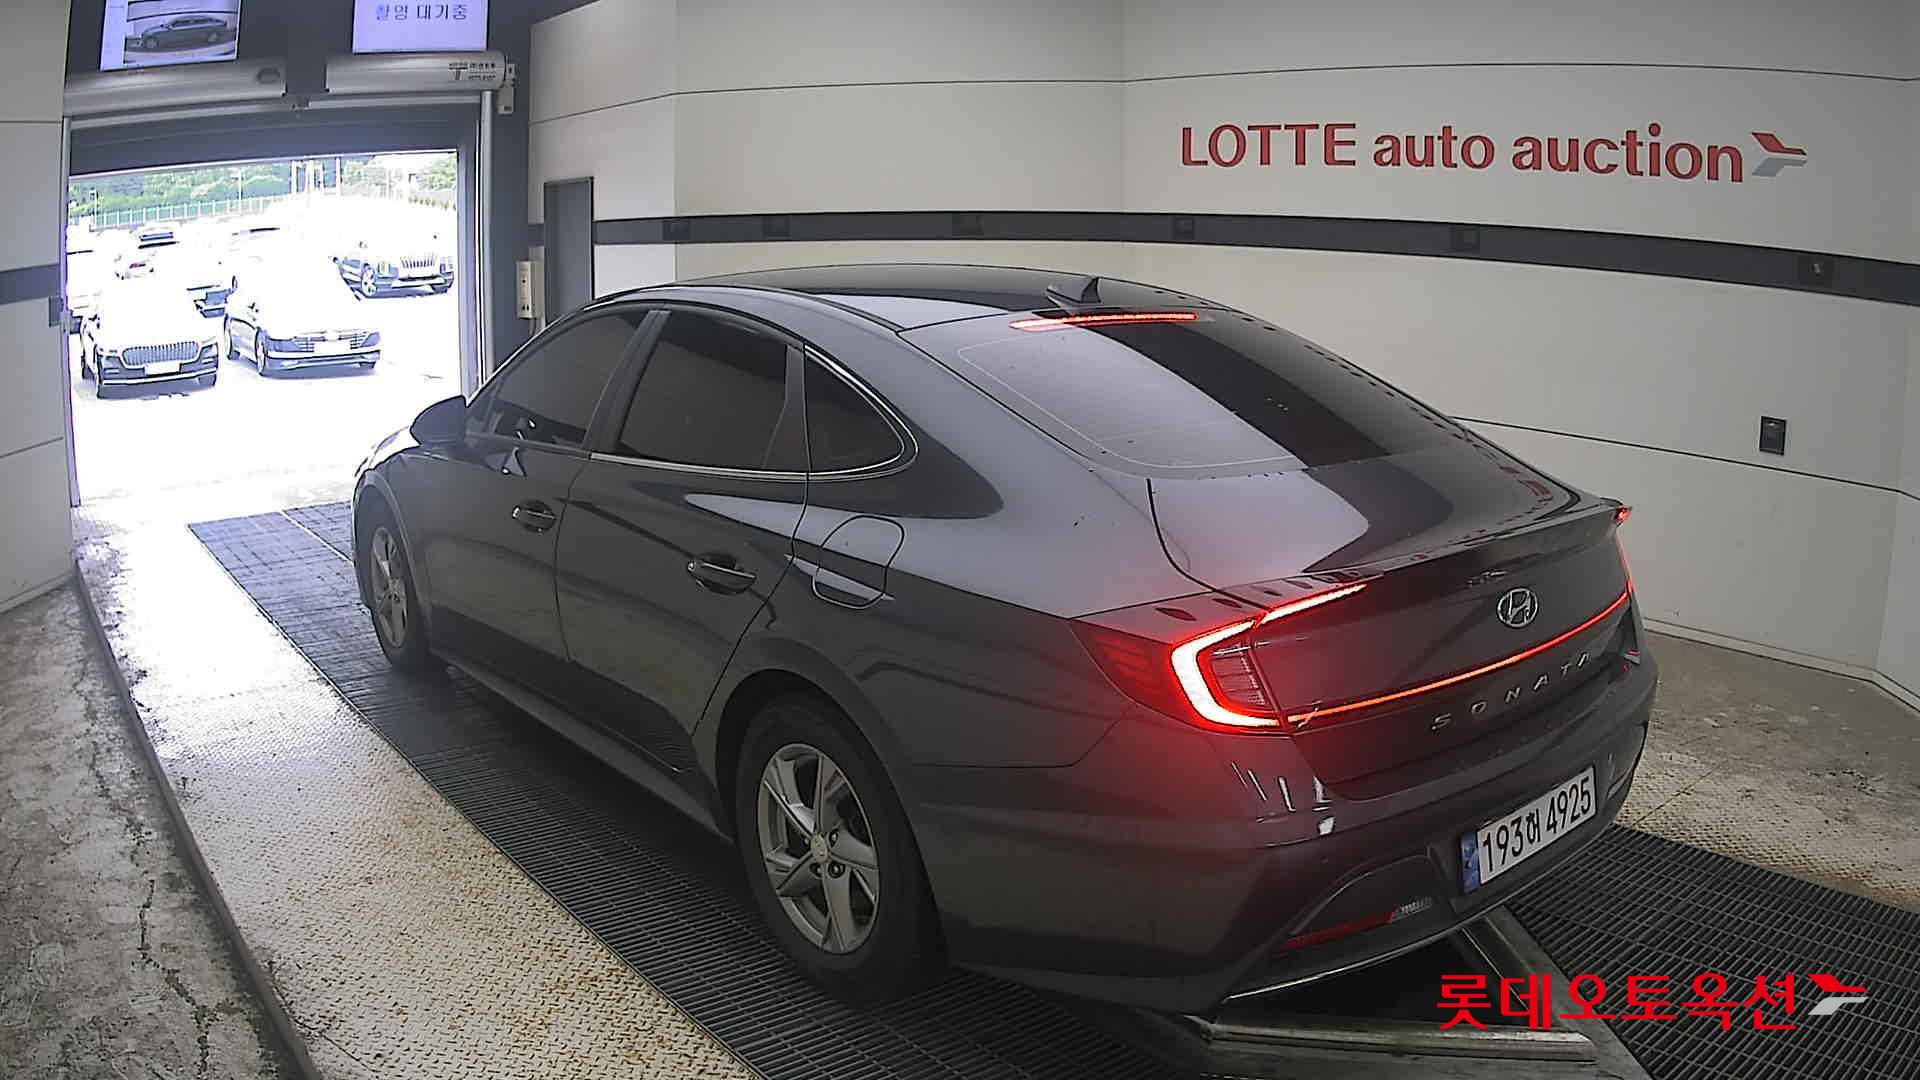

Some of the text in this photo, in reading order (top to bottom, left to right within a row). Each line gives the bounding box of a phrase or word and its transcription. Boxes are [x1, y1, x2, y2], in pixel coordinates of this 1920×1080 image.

[417, 4, 467, 20] 대기중
[1181, 122, 1744, 183] LOTTE auto auction
[1431, 651, 1590, 730] SONATA
[1482, 775, 1591, 873] 193허 4925
